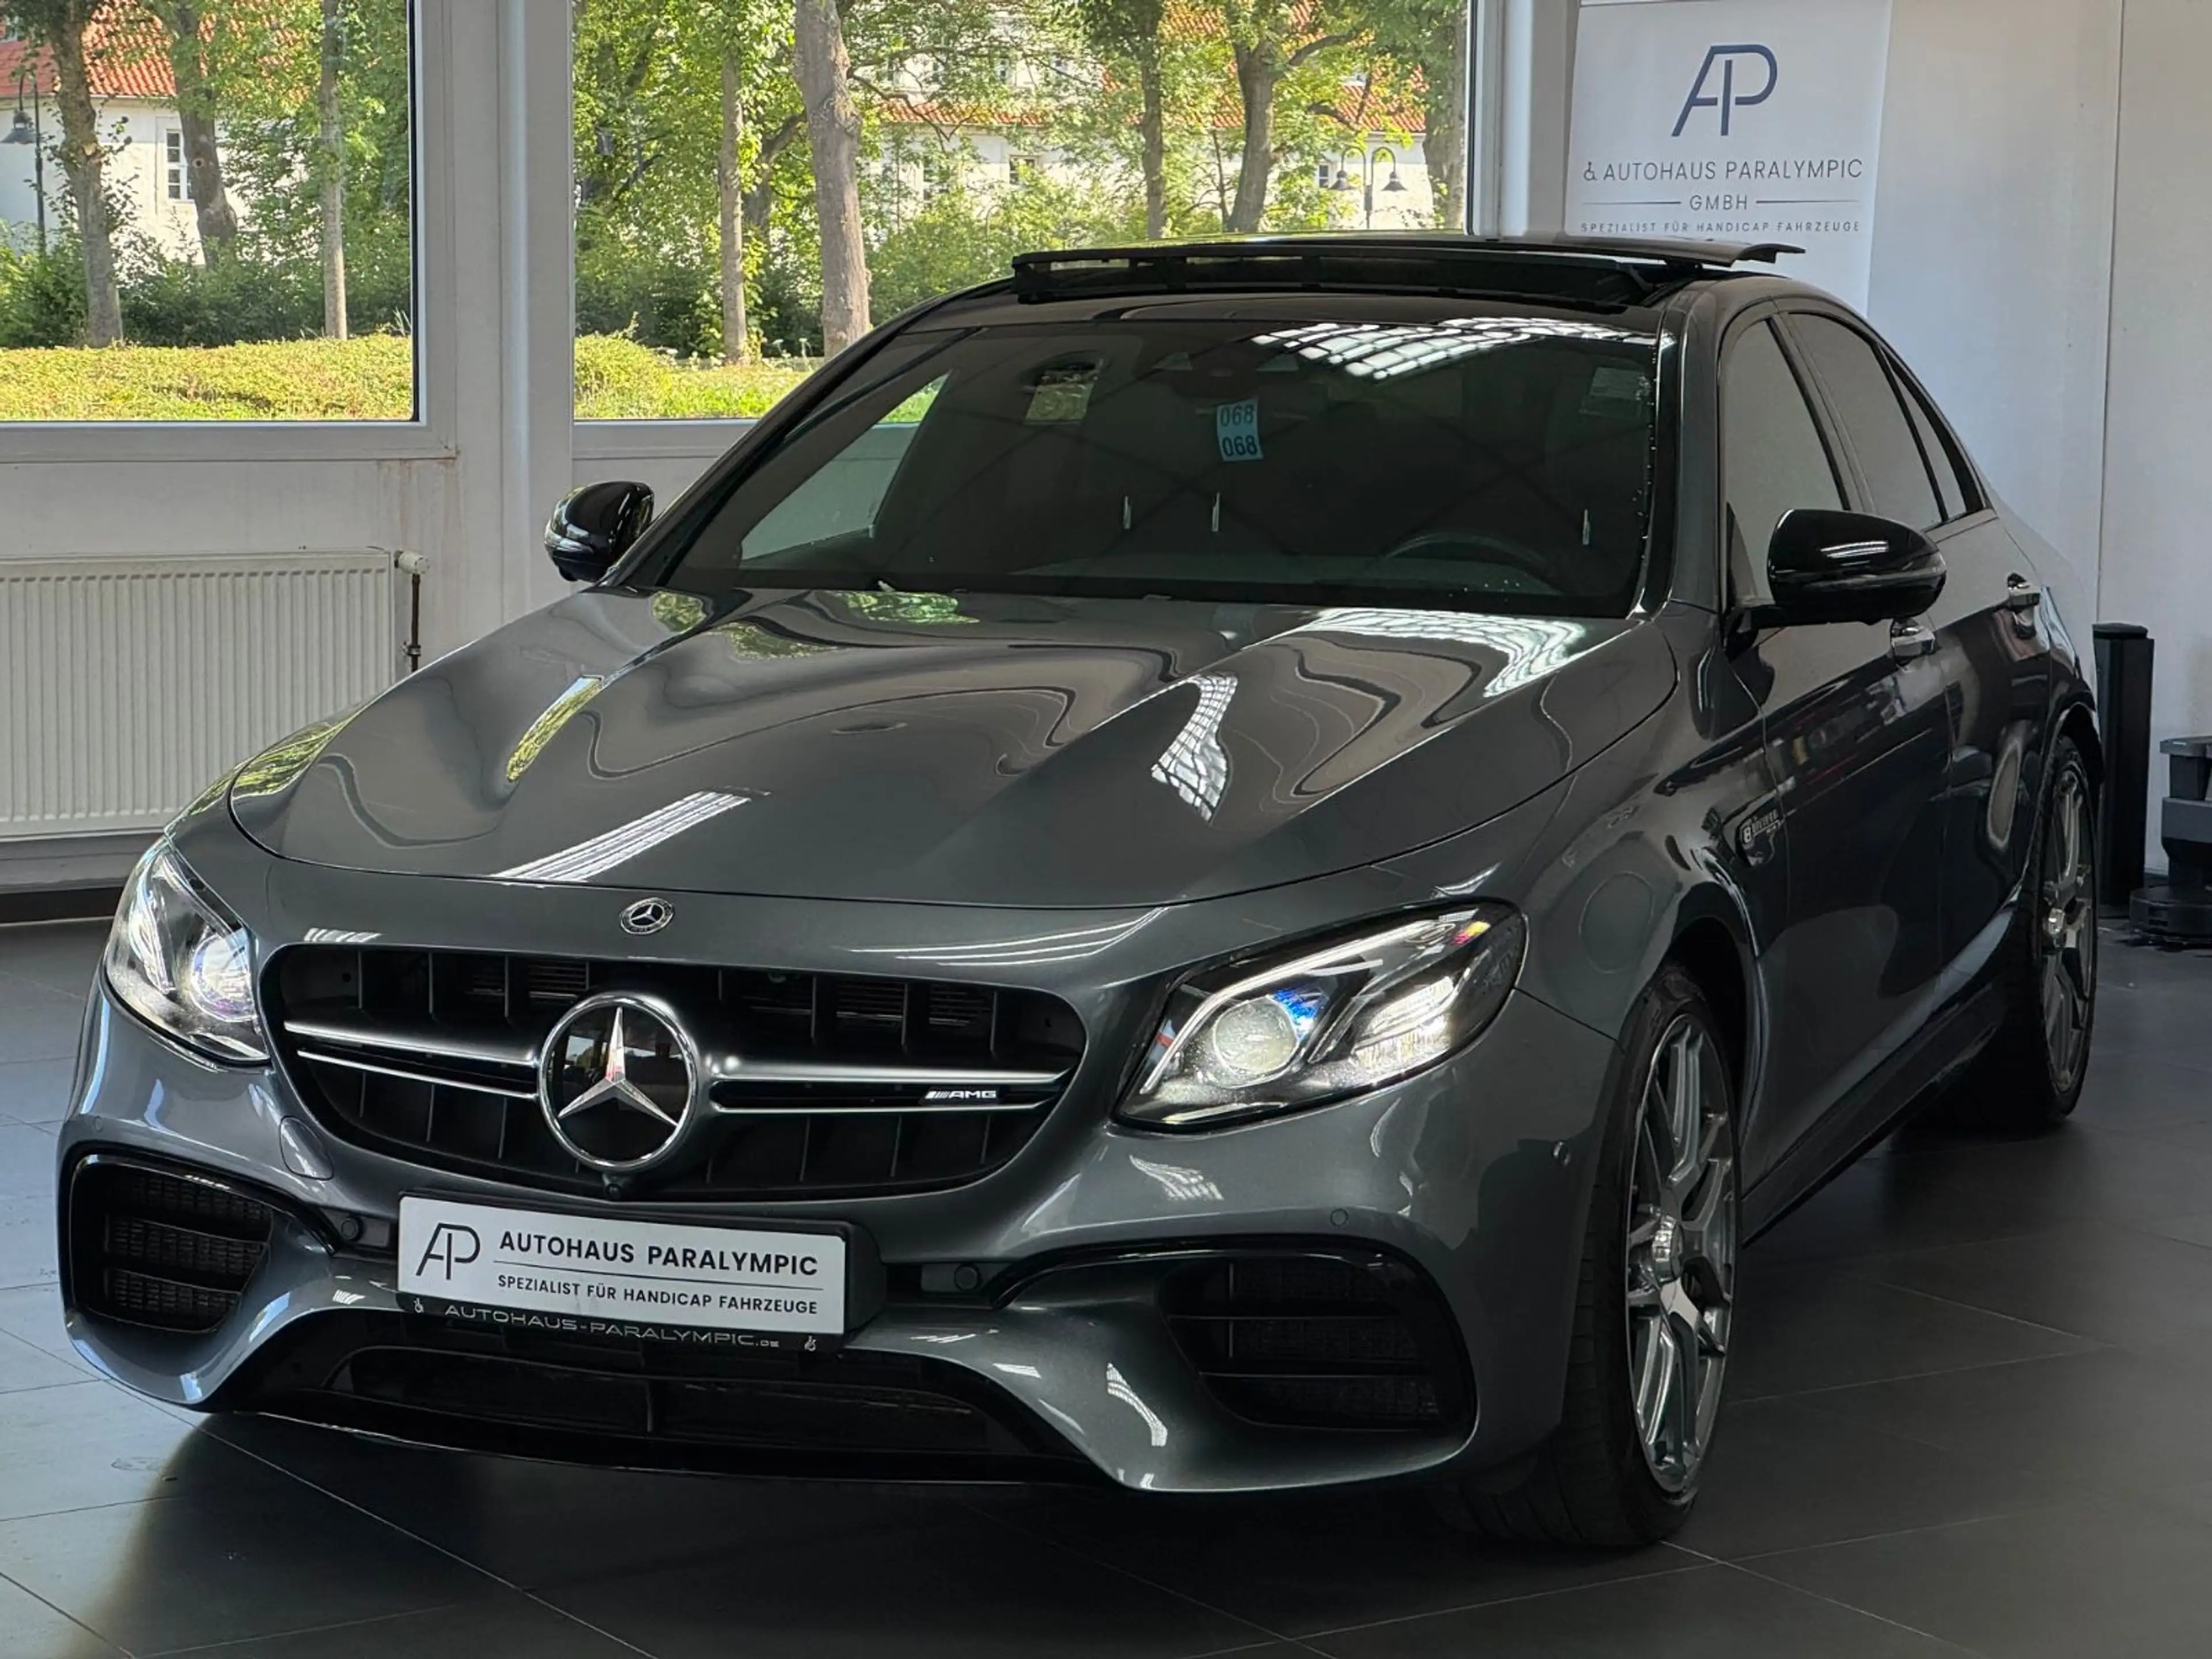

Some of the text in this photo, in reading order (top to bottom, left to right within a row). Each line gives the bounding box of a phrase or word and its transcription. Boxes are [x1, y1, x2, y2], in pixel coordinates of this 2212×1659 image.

[1671, 44, 1777, 137] AP
[1603, 158, 1863, 181] AUTOHAUS PARALYMPIC
[1689, 194, 1748, 211] GMBH
[1581, 221, 1859, 233] SPEZIALIST FÜR HANDICAP FAHRZEUGE
[1221, 405, 1254, 427] 068
[1222, 435, 1257, 457] 068
[949, 1090, 996, 1099] AMG
[499, 1230, 819, 1277] AUTOHAUS PARALYMPIC
[498, 1274, 817, 1315] SPEZIALIST FÜR HANDICAP FAHRZEUGE
